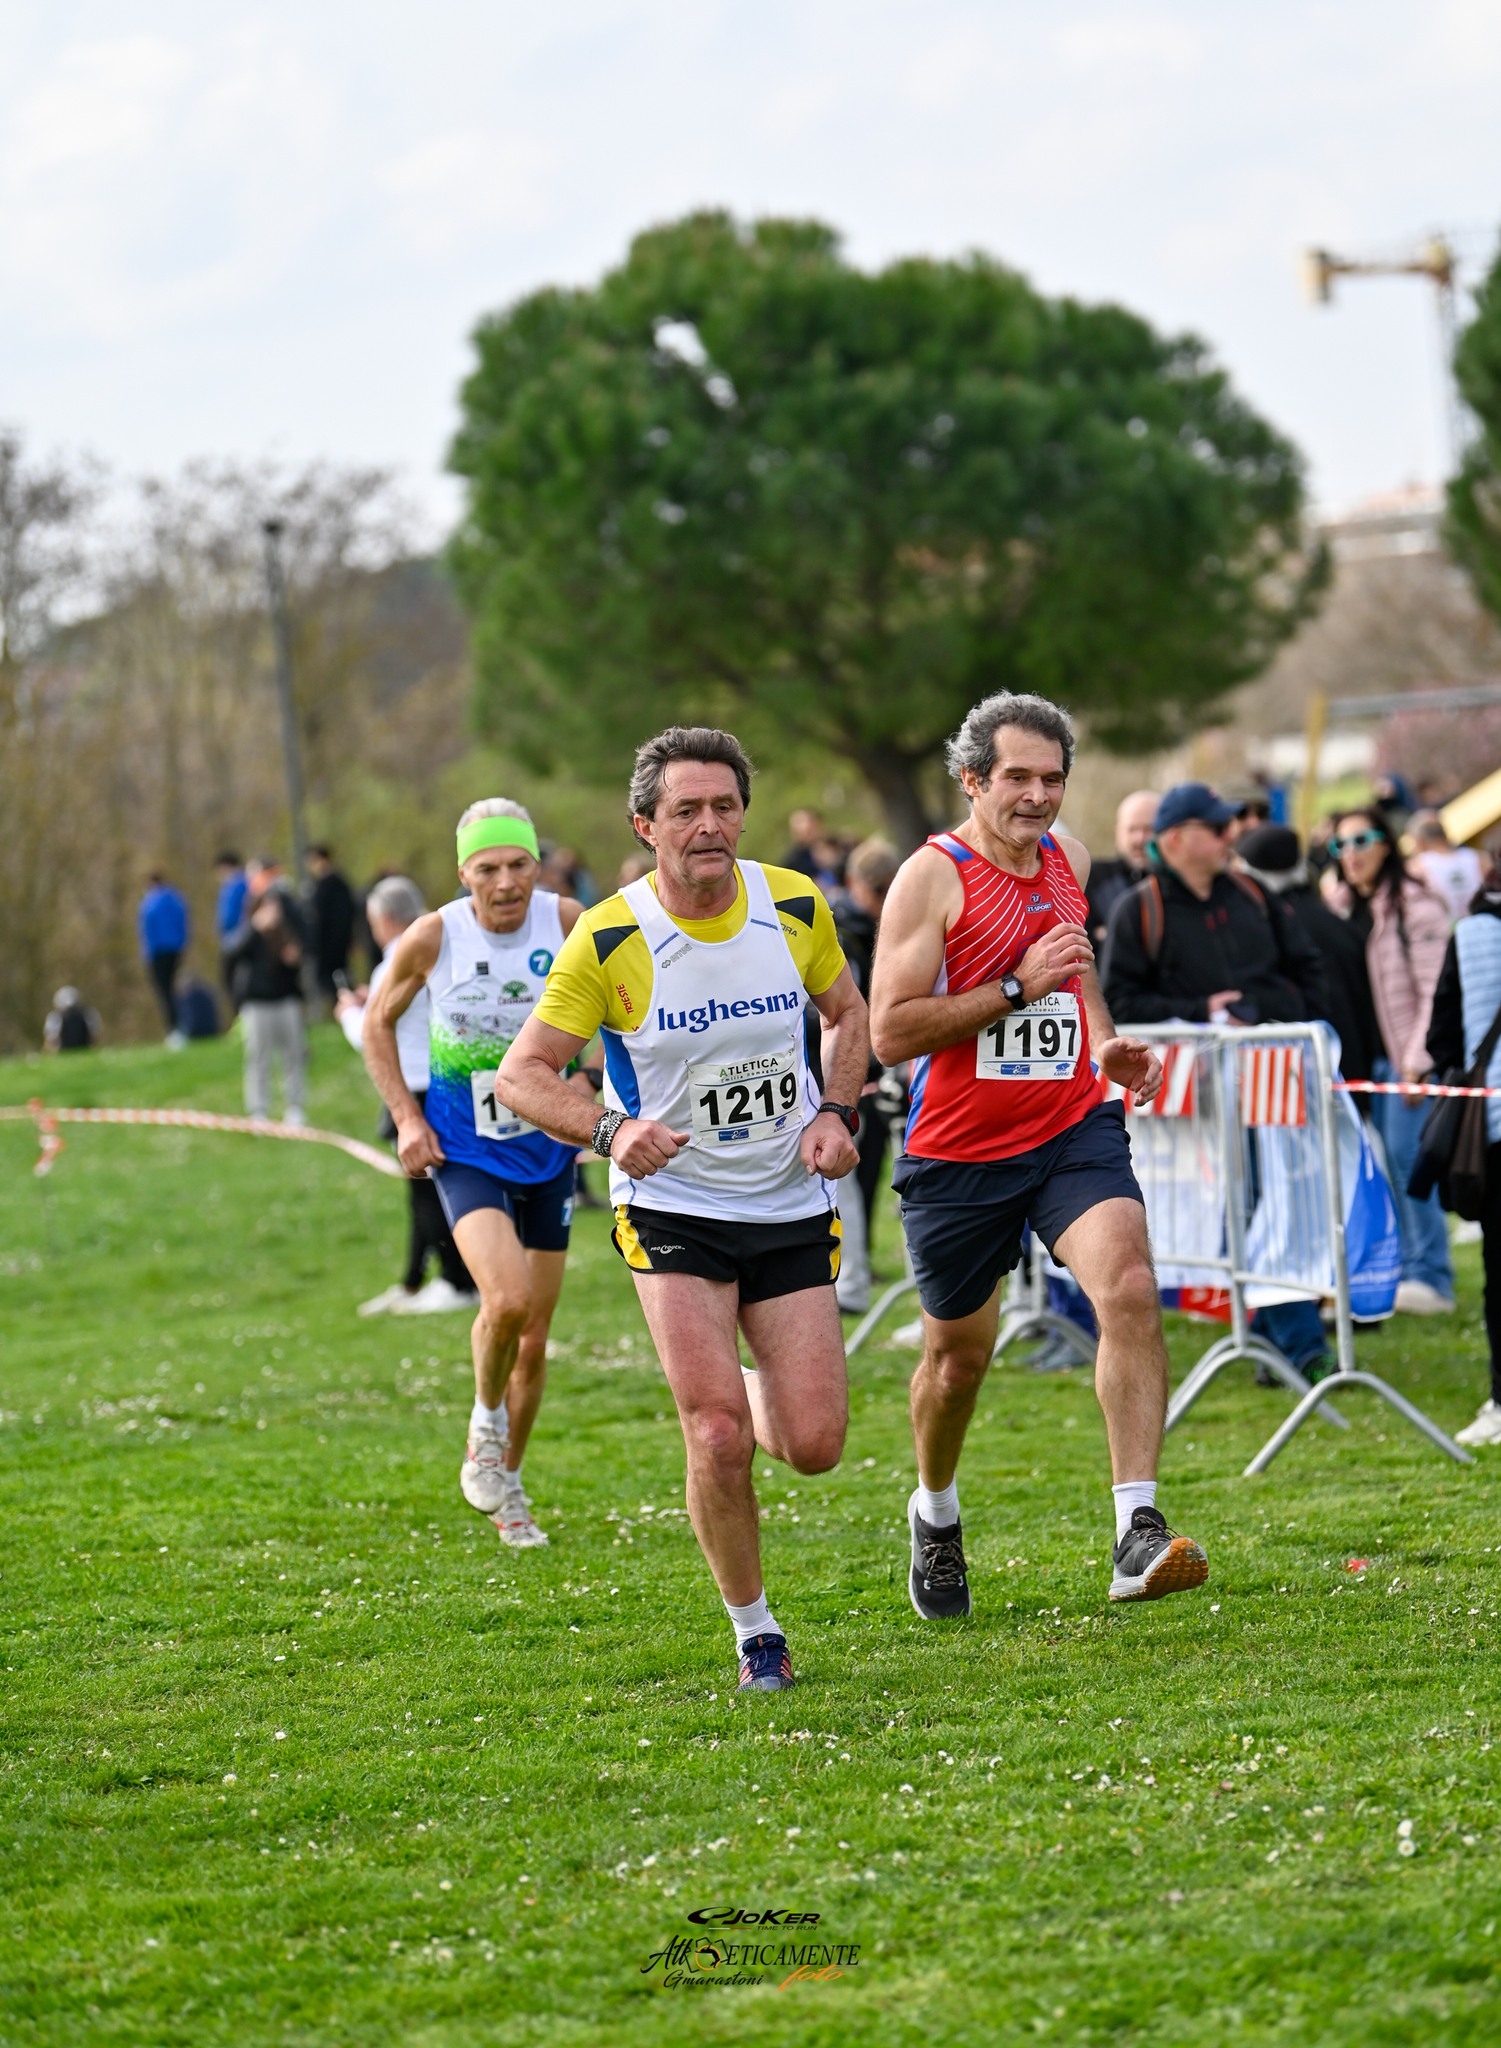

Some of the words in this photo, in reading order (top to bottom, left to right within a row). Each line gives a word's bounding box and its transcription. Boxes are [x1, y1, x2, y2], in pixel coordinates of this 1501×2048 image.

[616, 983, 634, 1015] TRIESTE
[657, 991, 799, 1033] lughesina
[987, 1018, 1077, 1058] 1197
[720, 1058, 778, 1077] ATLETICA
[699, 1072, 797, 1126] 1219
